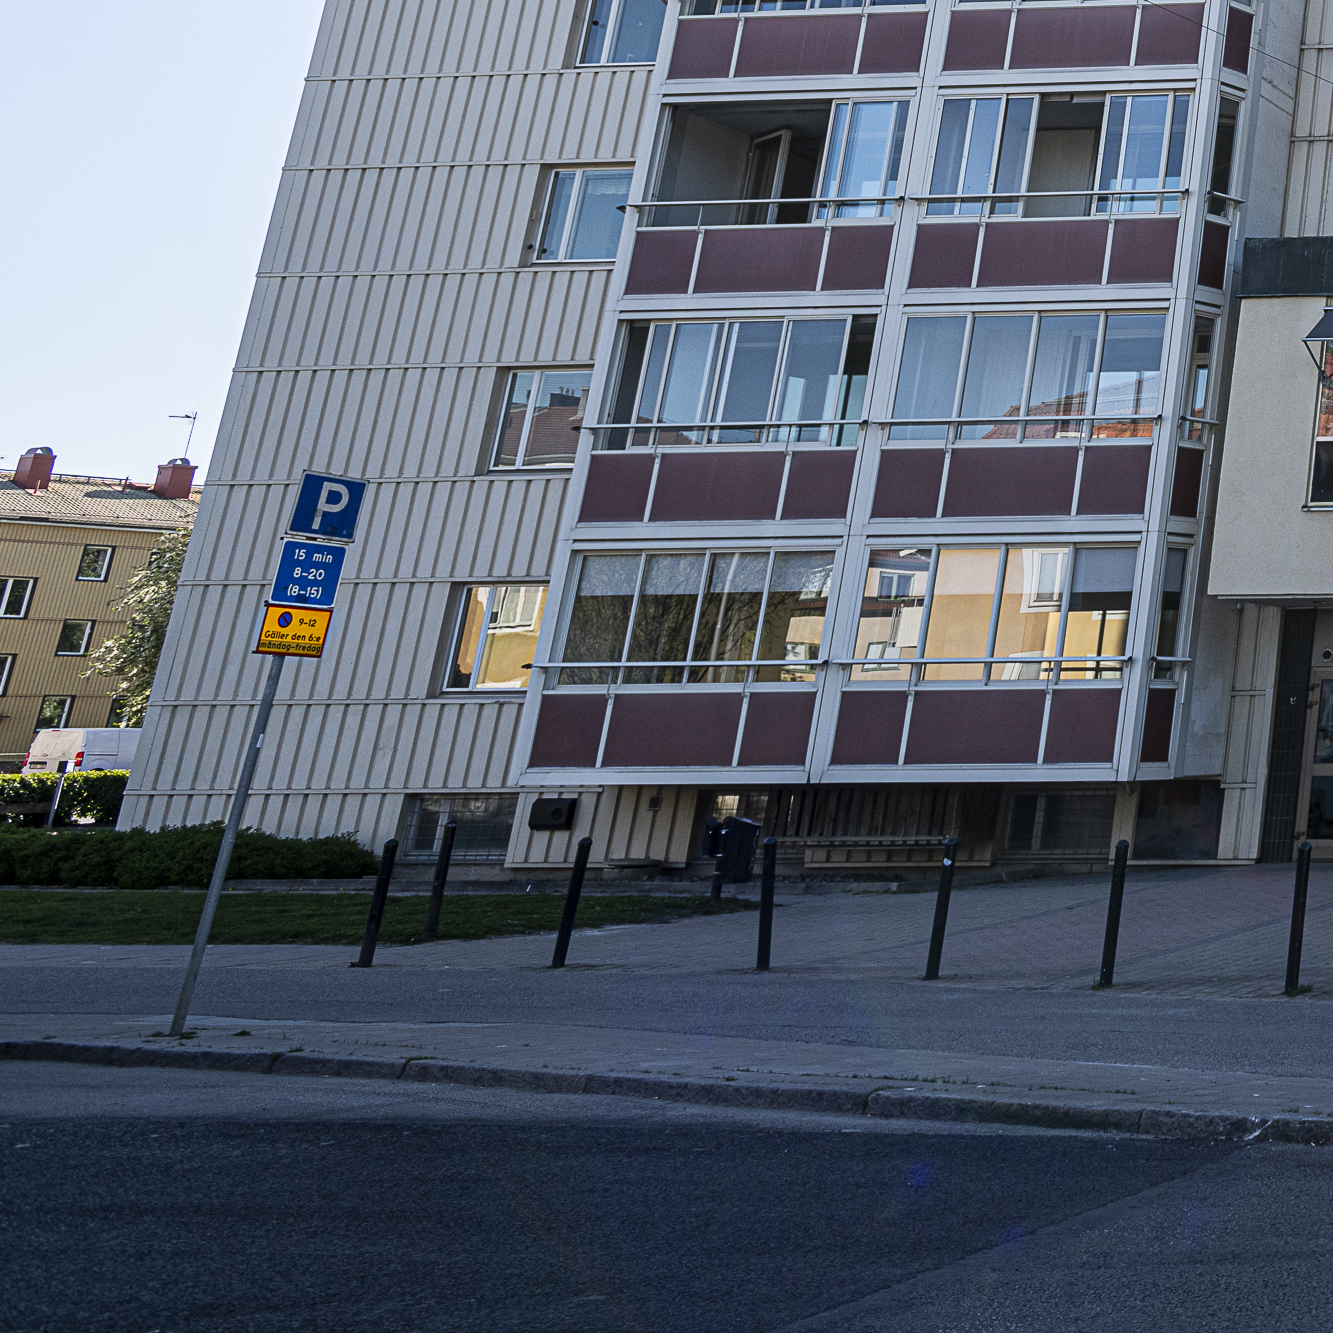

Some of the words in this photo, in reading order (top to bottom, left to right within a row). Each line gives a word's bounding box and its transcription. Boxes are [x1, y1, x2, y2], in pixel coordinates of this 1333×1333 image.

[311, 481, 350, 530] P
[294, 548, 307, 560] 15
[312, 552, 333, 563] min
[293, 567, 325, 580] 8-20
[287, 583, 322, 599] (8-15)
[298, 618, 317, 627] 9-12
[264, 630, 289, 639] Gäller
[291, 632, 306, 641] den
[308, 634, 321, 642] 6:e
[260, 641, 321, 654] måndag-fredag
